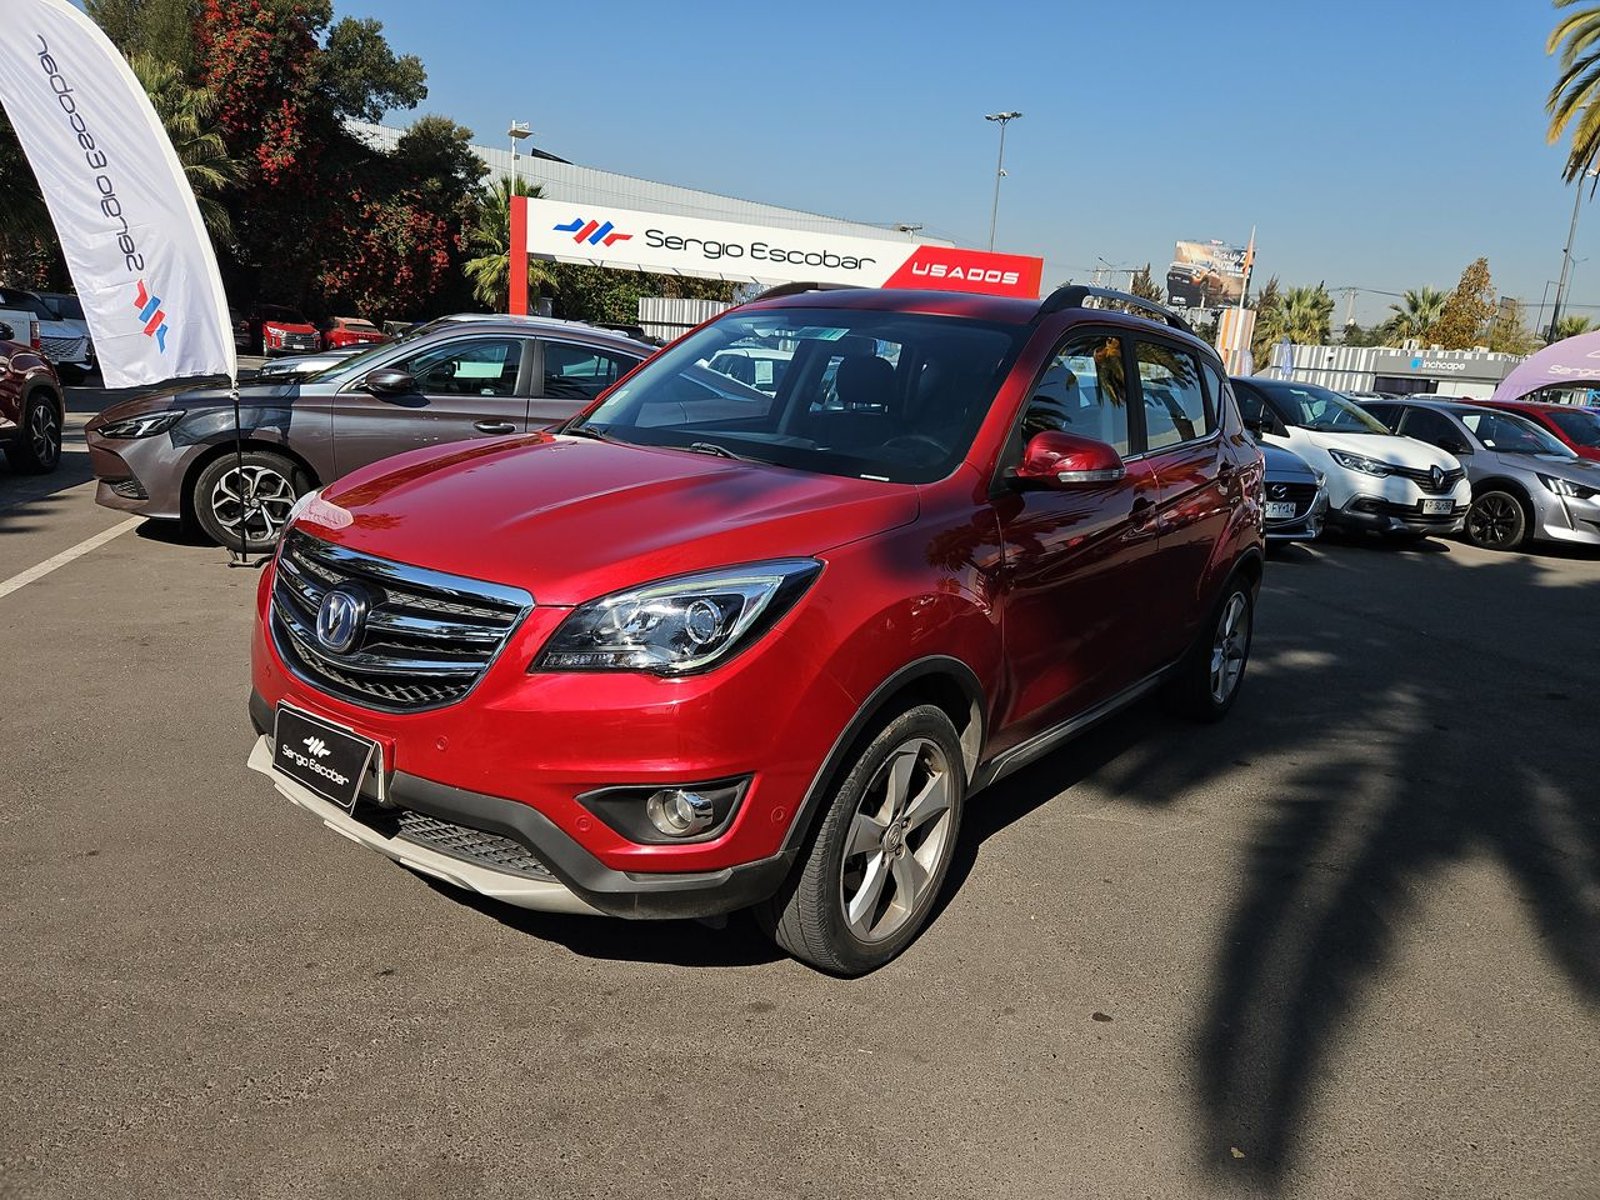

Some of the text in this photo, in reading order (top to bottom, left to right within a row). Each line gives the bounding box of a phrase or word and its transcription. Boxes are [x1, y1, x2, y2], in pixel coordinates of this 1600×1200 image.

[644, 229, 876, 270] Sergio Escobar
[911, 261, 1020, 285] USADOS
[308, 757, 350, 786] Escobar
